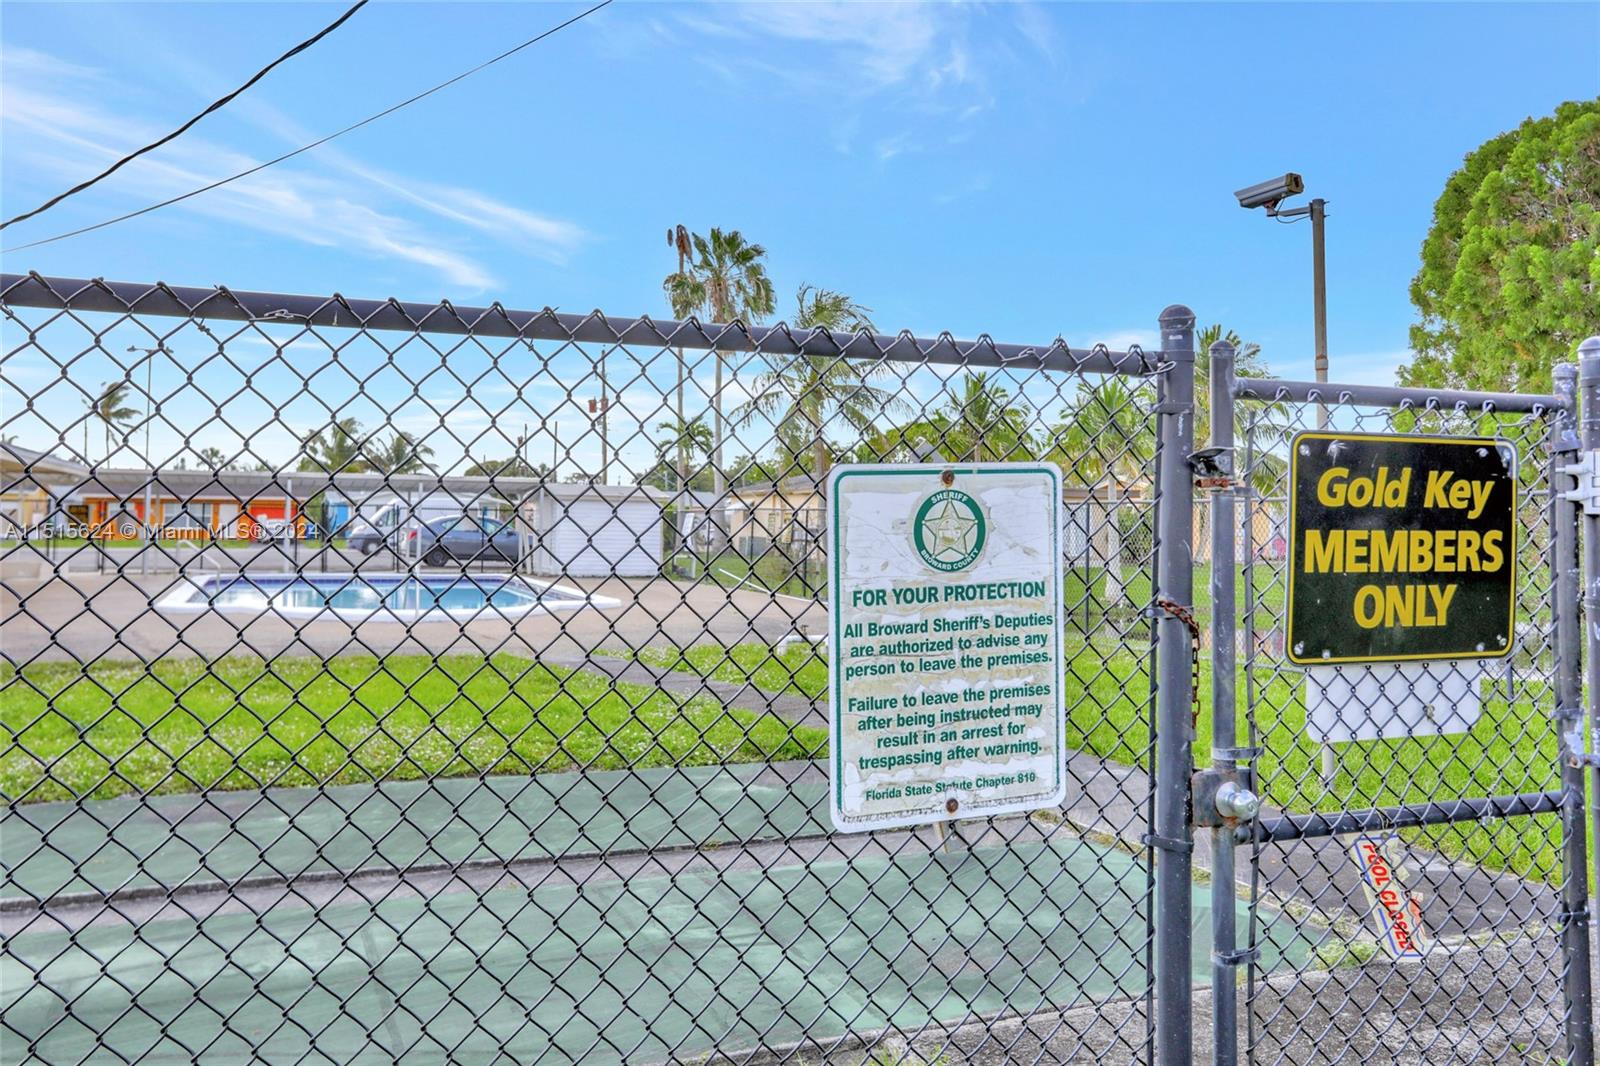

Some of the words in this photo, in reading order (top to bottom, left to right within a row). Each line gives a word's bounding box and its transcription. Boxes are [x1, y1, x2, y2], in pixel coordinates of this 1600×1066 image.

[931, 491, 968, 504] SHERIFF
[1317, 467, 1412, 508] Gold
[1423, 470, 1495, 520] Key
[921, 549, 952, 570] BROWARD
[953, 548, 978, 570] COUNTY
[1304, 530, 1504, 573] MEMBERS
[852, 588, 887, 607] FOR
[892, 586, 939, 604] YOUR
[944, 581, 1046, 602] PROTECTION
[1354, 584, 1457, 629] ONLY
[844, 623, 863, 638] All
[867, 619, 929, 637] Broward
[995, 613, 1053, 630] Deputies
[850, 645, 874, 657] are
[879, 637, 954, 655] authorized
[958, 637, 972, 650] to
[976, 633, 1020, 648] advise
[1024, 634, 1048, 647] any
[846, 663, 896, 681] person
[900, 660, 915, 673] to
[919, 658, 956, 672] leave
[961, 654, 983, 669] the
[987, 651, 1053, 670] premises.
[848, 696, 898, 712] Failure
[902, 694, 917, 708] to
[921, 690, 959, 706] leave
[963, 688, 985, 703] the
[989, 684, 1051, 702] premises
[857, 717, 892, 731] after
[896, 713, 936, 729] being
[940, 706, 1010, 723] instructed
[1015, 703, 1043, 718] may
[877, 732, 918, 749] result
[922, 730, 936, 744] in
[940, 729, 957, 742] an
[962, 725, 1003, 739] arrest
[1007, 722, 1025, 735] for
[859, 752, 942, 770] trespassing
[947, 746, 980, 761] after
[984, 741, 1042, 757] warning.
[865, 788, 902, 801] Florida
[905, 786, 933, 797] State
[975, 774, 1015, 789] Chapter
[1017, 771, 1036, 782] 810
